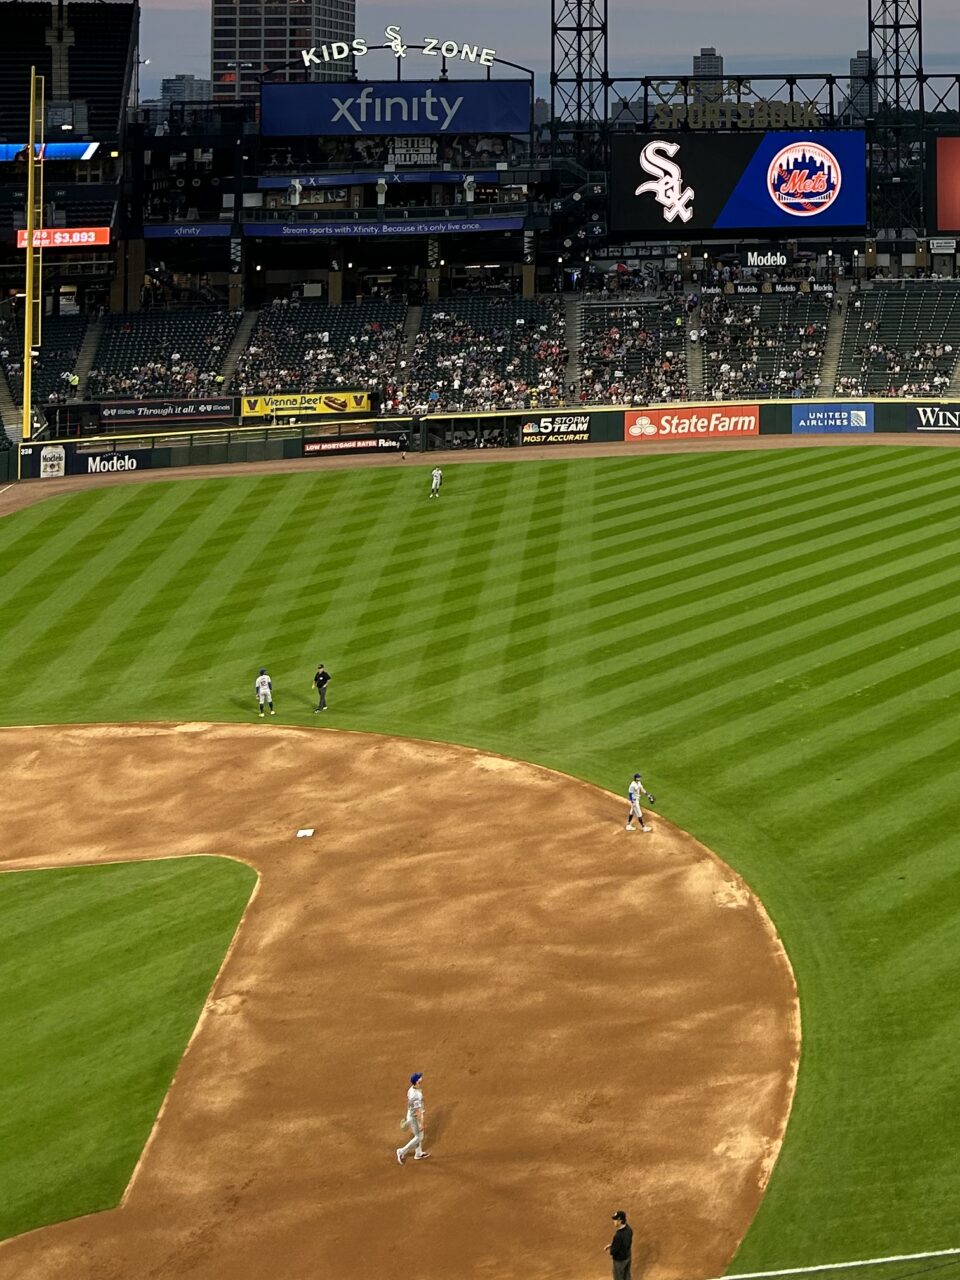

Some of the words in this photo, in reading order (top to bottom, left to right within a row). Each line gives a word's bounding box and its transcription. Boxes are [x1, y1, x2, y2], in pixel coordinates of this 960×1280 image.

[301, 38, 368, 67] KIDS
[422, 37, 496, 67] ZONE
[330, 87, 465, 132] xfinity
[654, 100, 820, 129] SPORTSBOOK
[394, 136, 431, 148] BETTER
[387, 153, 438, 165] BALLPARK
[780, 169, 829, 193] Mets
[174, 227, 201, 237] xfinity
[282, 226, 308, 235] Stream
[309, 226, 332, 236] sports
[334, 225, 351, 234] with
[382, 224, 415, 233] Because
[417, 223, 428, 232] it's
[429, 223, 446, 233] only
[447, 223, 460, 231] live
[747, 251, 787, 266] Modelo
[701, 286, 722, 294] Modelo
[737, 285, 758, 293] Modelo
[775, 284, 796, 292] Modelo
[813, 283, 834, 291] Modelo
[300, 395, 323, 405] Beef
[137, 405, 174, 416] Through
[174, 405, 181, 414] it
[182, 405, 197, 414] all.
[540, 417, 553, 433] 5
[554, 416, 590, 425] STORM
[799, 419, 849, 427] AIRLINES
[553, 423, 589, 432] TEAM
[523, 435, 547, 443] MOST
[547, 433, 590, 442] ACCURATE
[306, 443, 321, 451] LOW
[321, 441, 356, 450] MORTGAGE
[87, 455, 137, 473] Modelo
